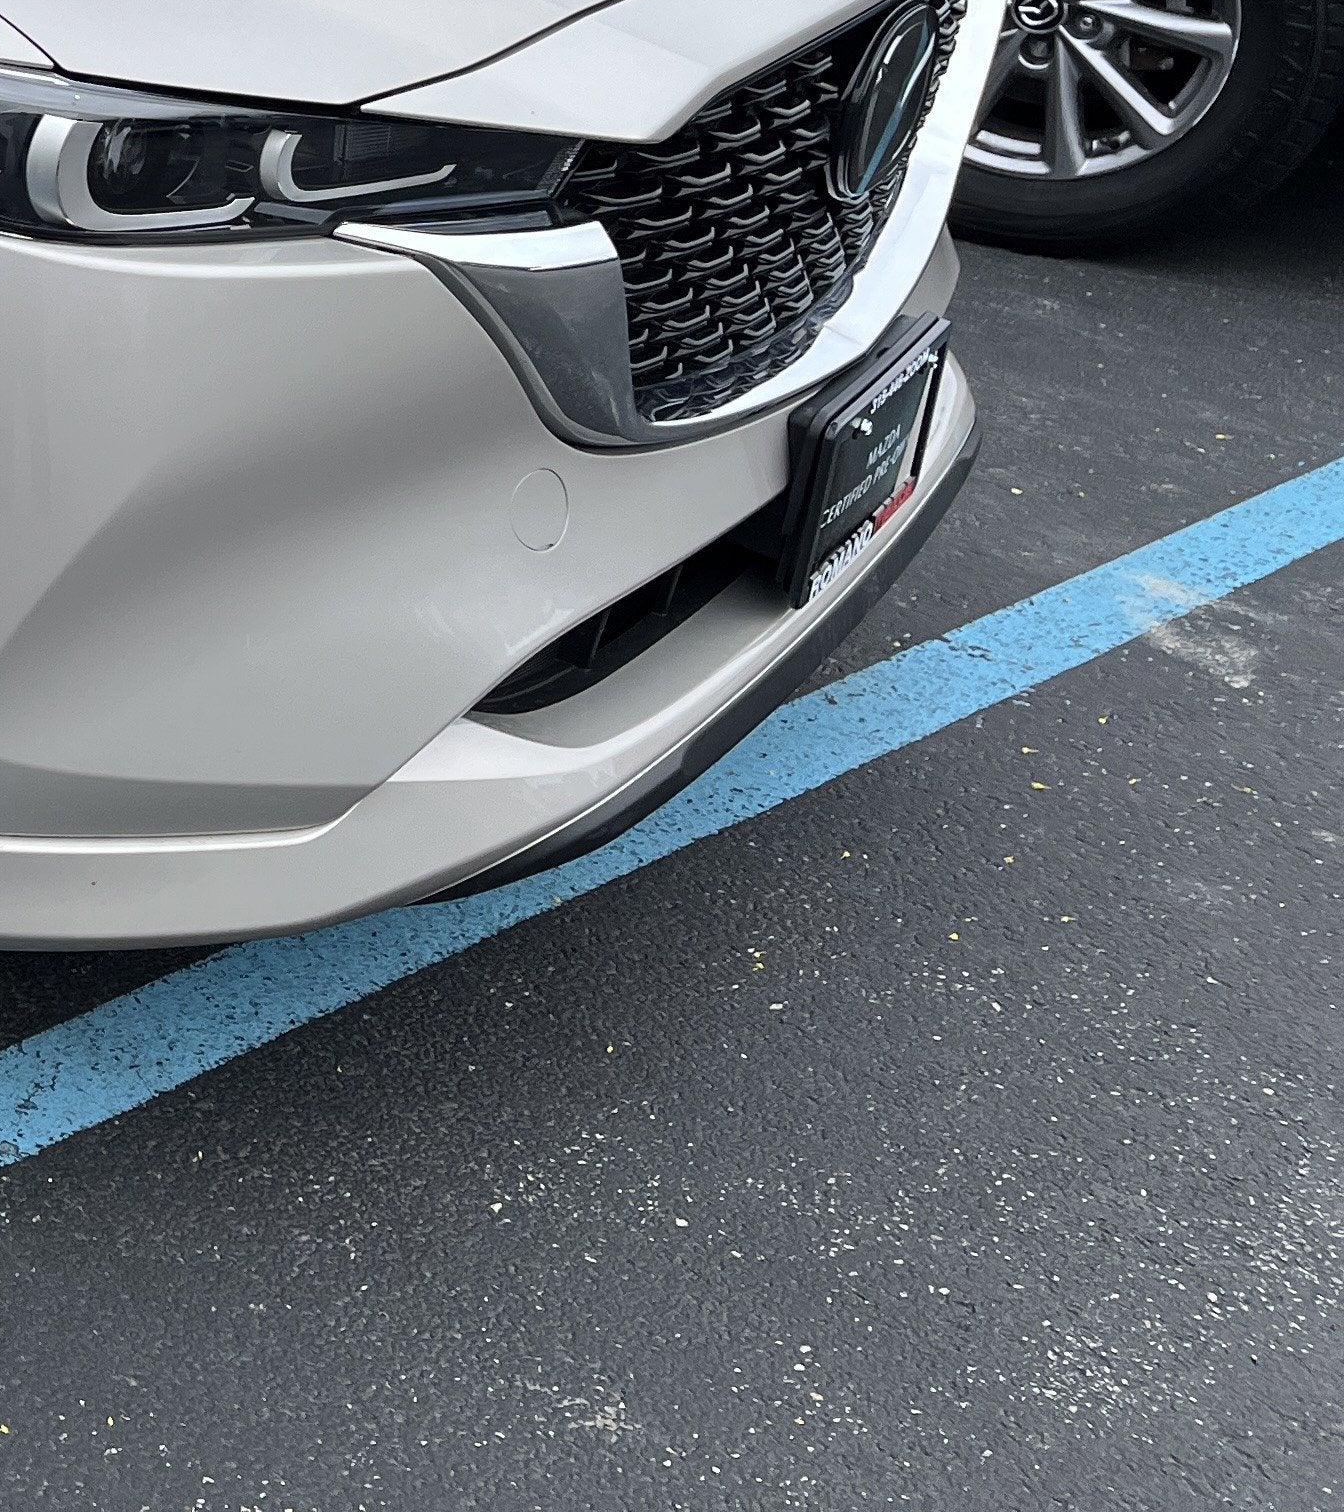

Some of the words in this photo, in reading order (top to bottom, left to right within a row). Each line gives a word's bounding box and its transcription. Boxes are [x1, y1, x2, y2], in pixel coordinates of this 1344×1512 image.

[865, 423, 901, 469] MAZDA
[820, 474, 873, 529] CERTIFIED
[808, 519, 874, 602] ROMANO
